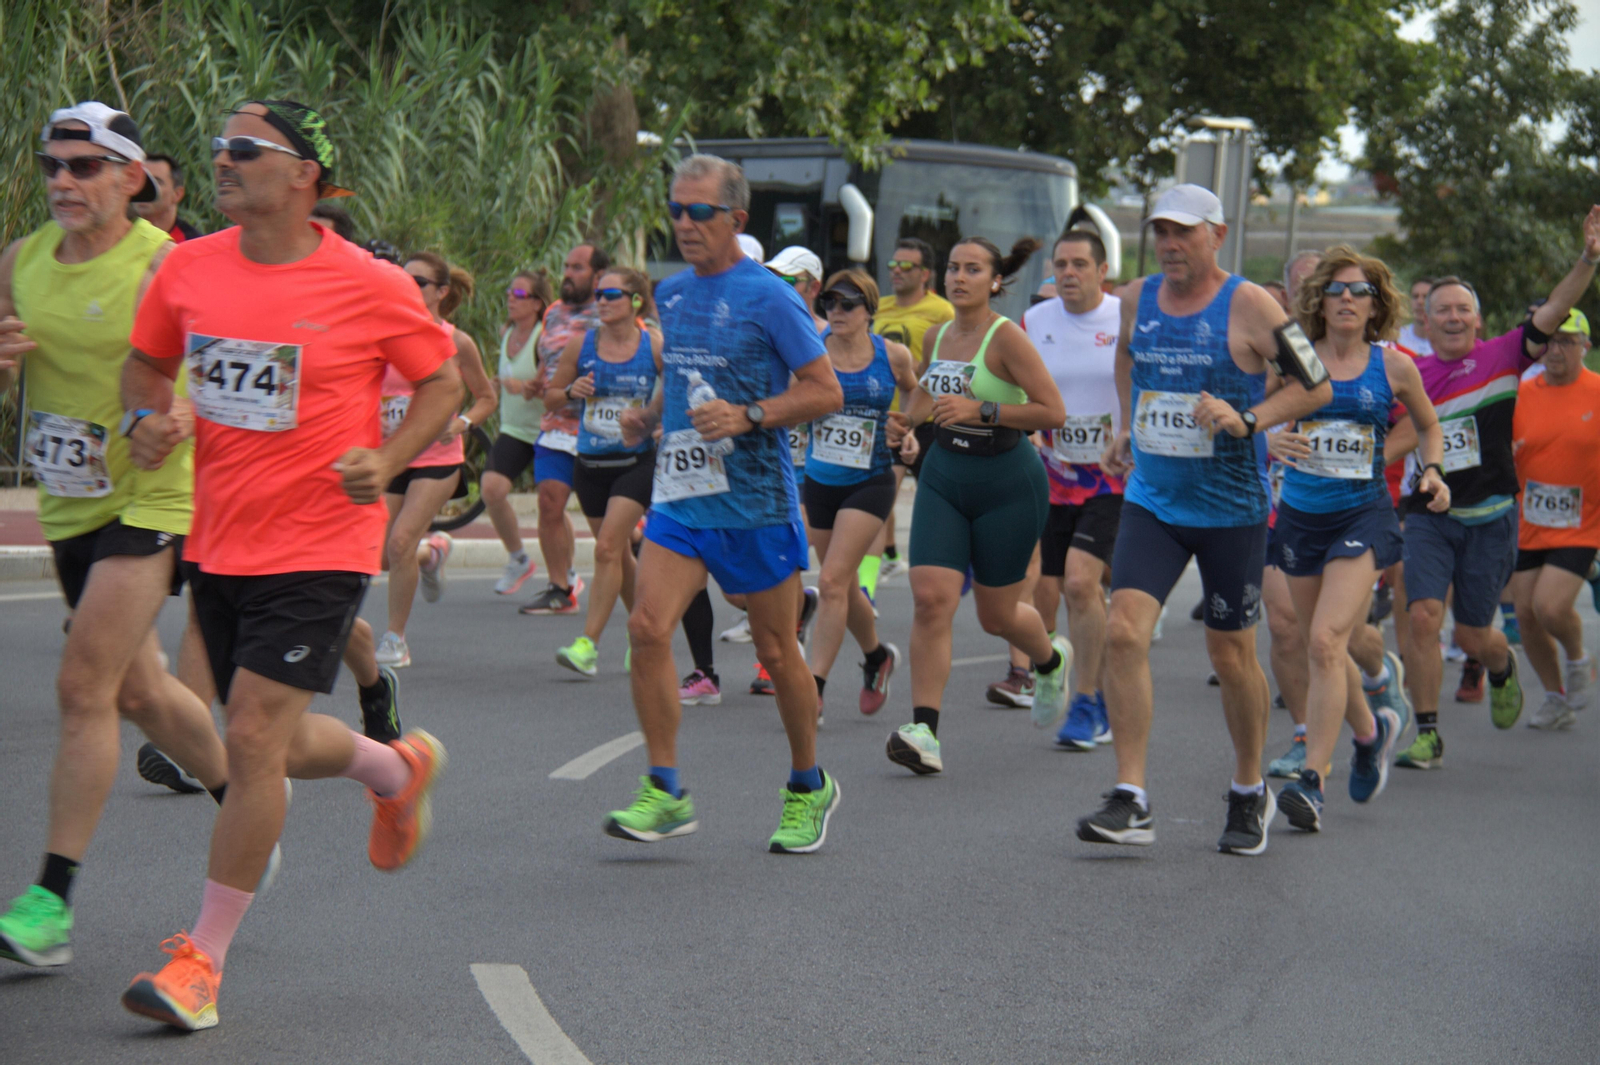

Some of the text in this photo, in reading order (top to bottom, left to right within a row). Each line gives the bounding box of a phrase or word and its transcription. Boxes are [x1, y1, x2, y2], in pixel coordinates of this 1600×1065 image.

[206, 359, 276, 396] 474
[930, 374, 962, 394] 783
[1148, 409, 1197, 429] 1163
[822, 426, 862, 447] 739
[952, 437, 970, 448] FILA
[1061, 427, 1102, 444] 697
[1311, 436, 1361, 454] 1164
[32, 433, 85, 467] 473
[1532, 494, 1570, 511] 765
